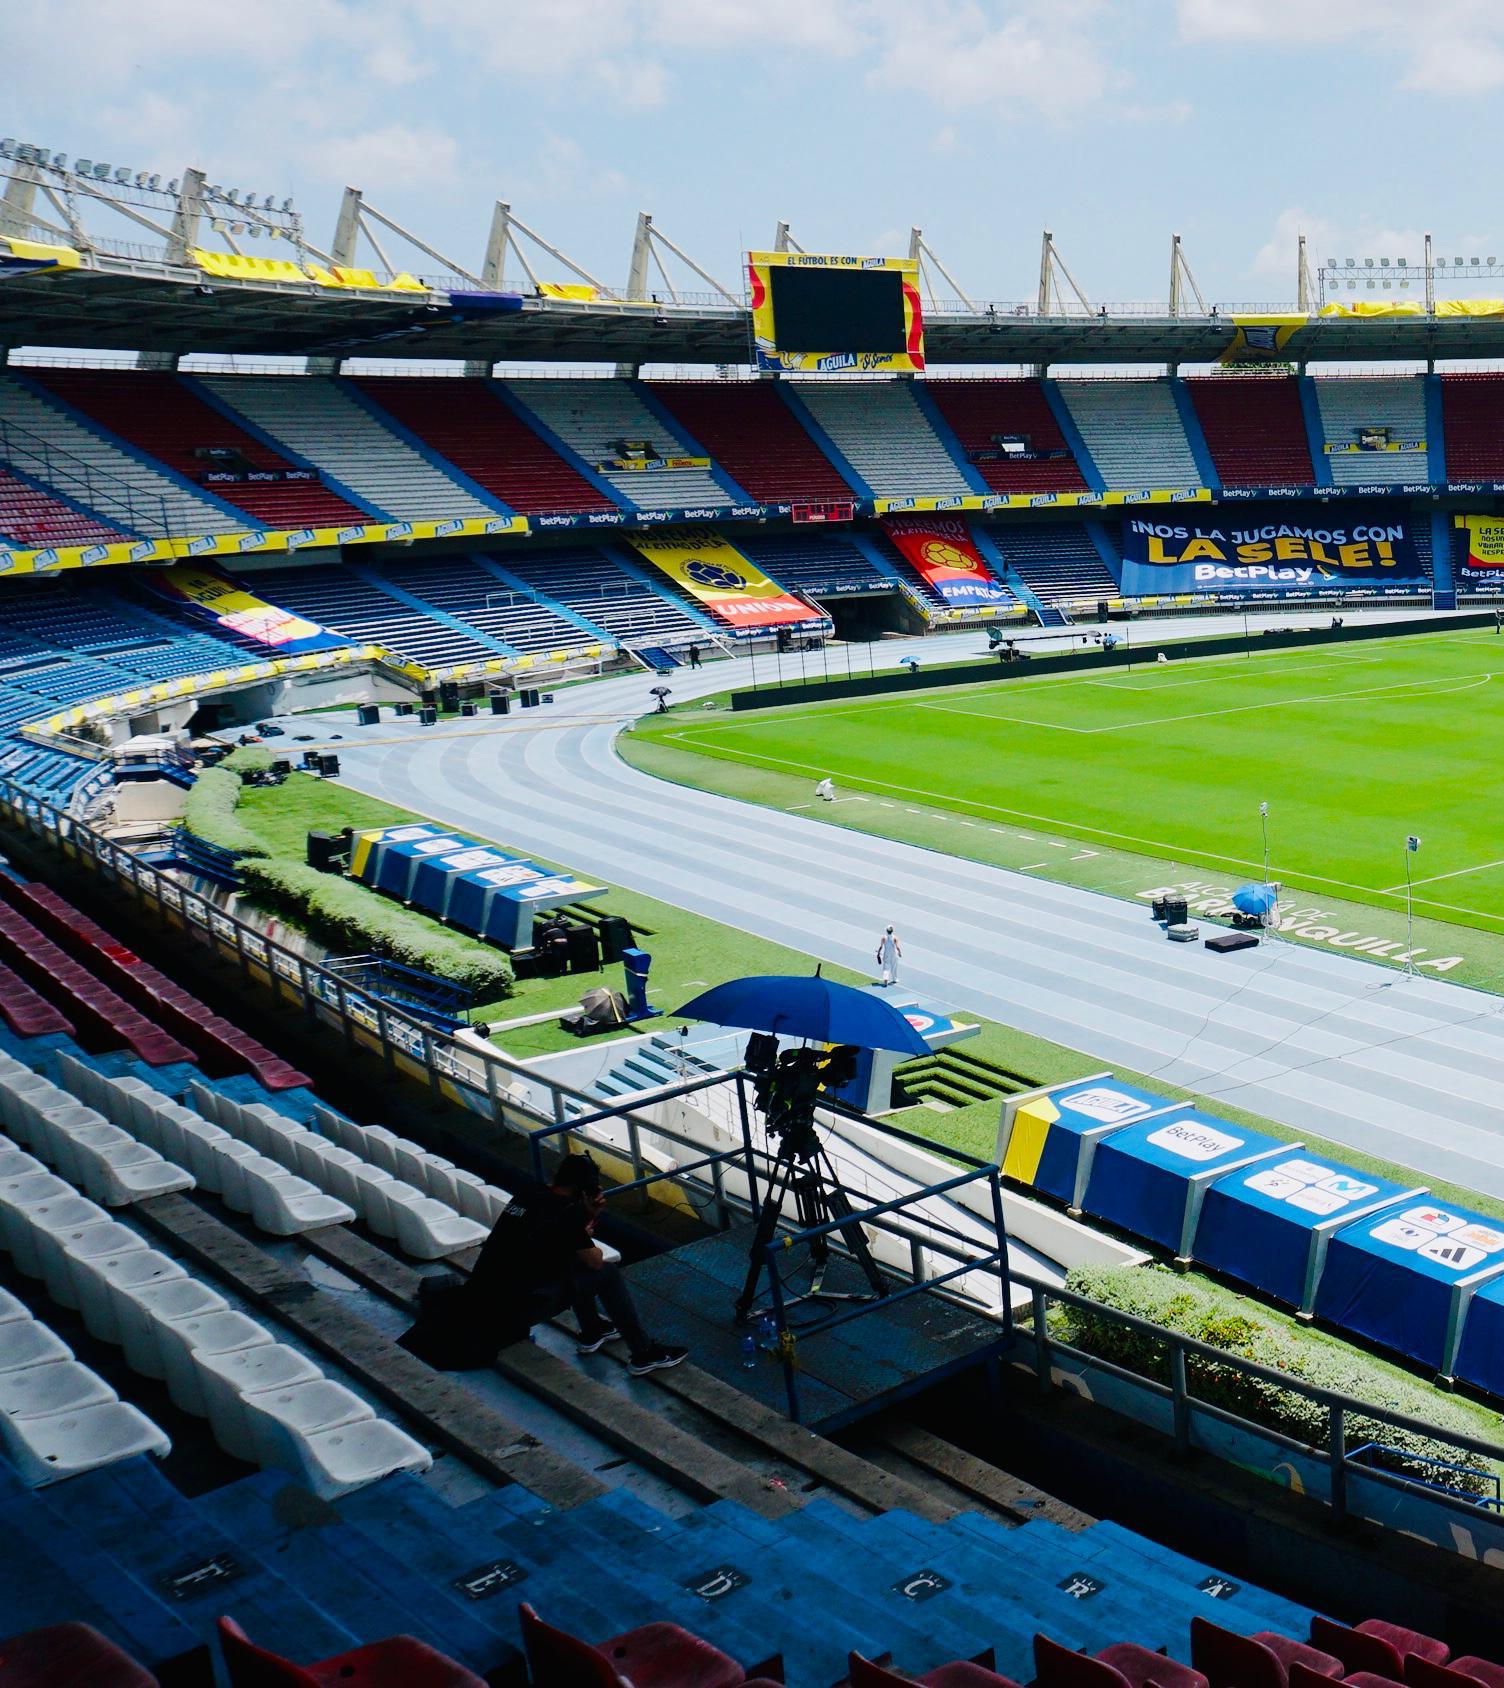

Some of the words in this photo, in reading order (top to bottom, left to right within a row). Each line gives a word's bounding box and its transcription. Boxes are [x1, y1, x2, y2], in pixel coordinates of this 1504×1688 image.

[787, 256, 796, 265] EL
[830, 256, 838, 265] ES
[841, 256, 857, 265] CON
[819, 353, 856, 371] AGUILA
[1268, 488, 1296, 496] BetPlay
[1313, 487, 1341, 495] BetPlay
[1358, 486, 1386, 494] BetPlay
[1403, 485, 1431, 493] BetPlay
[1448, 484, 1476, 492] BetPlay
[1223, 489, 1250, 498] BetPlay
[684, 509, 714, 519] BetPlay
[732, 507, 760, 516] BetPlay
[540, 517, 570, 526] BetPlay
[588, 514, 619, 524] BetPlay
[636, 512, 667, 522] BetPlay
[1195, 528, 1226, 541] LA
[1231, 524, 1347, 544] JUGAMOS
[1352, 525, 1404, 542] CON
[1479, 527, 1491, 535] LA
[1148, 536, 1227, 563] LA
[1236, 537, 1397, 568] SELE!
[1194, 564, 1313, 582] BetPlay
[1290, 907, 1337, 919] DE
[1166, 1126, 1225, 1153] BetPlay
